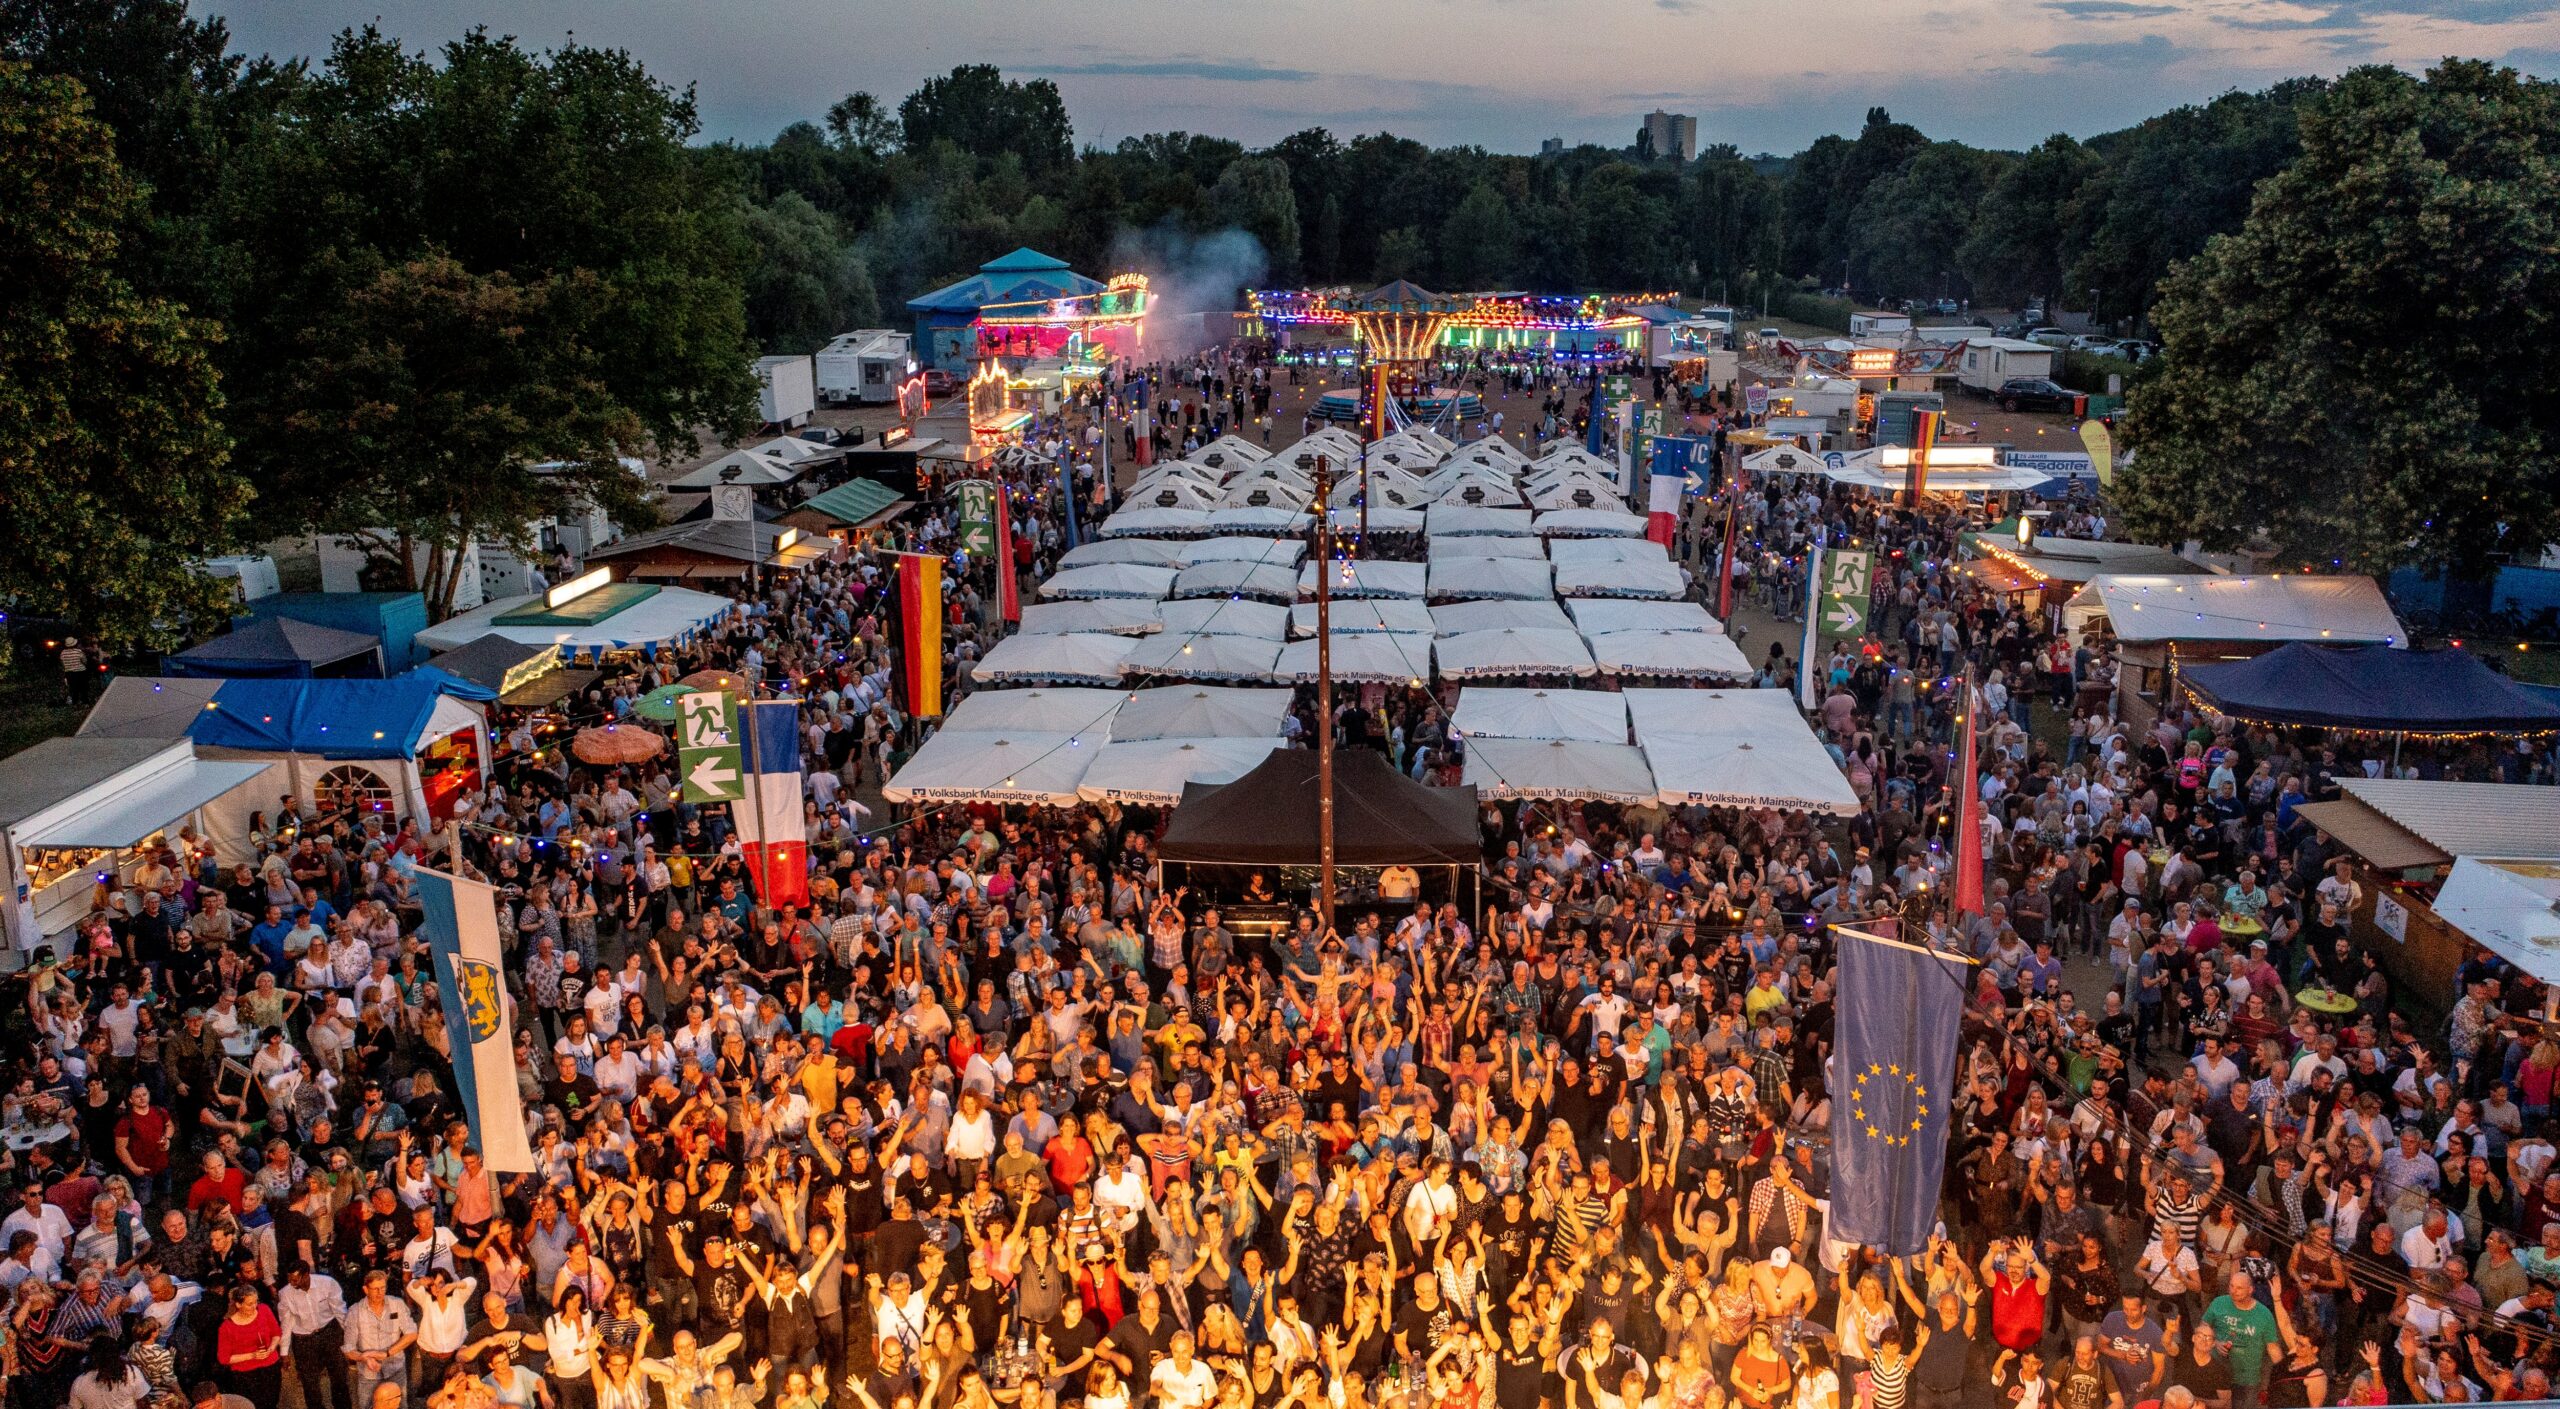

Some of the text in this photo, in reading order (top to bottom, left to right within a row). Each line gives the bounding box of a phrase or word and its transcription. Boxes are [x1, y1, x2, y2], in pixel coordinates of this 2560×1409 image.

[1142, 664, 1190, 675] Volksbank
[1192, 669, 1241, 679] Mainspitze
[1477, 663, 1573, 673] Volksbank Mainspitze eG
[1635, 664, 1732, 678] Volksbank Mainspitze eG
[1006, 670, 1045, 679] Volksbank
[1047, 671, 1090, 681] Mainspitze
[1309, 671, 1406, 683] Vobank Mainspitze eG
[928, 788, 1049, 802] Volksbank Mainspitze eG
[1123, 790, 1174, 803] Volksbank
[1491, 788, 1639, 804] Volksbank Mainspitze eG
[1705, 793, 1831, 811] Volksbank Mainspitze eG
[2071, 1380, 2094, 1405] H
